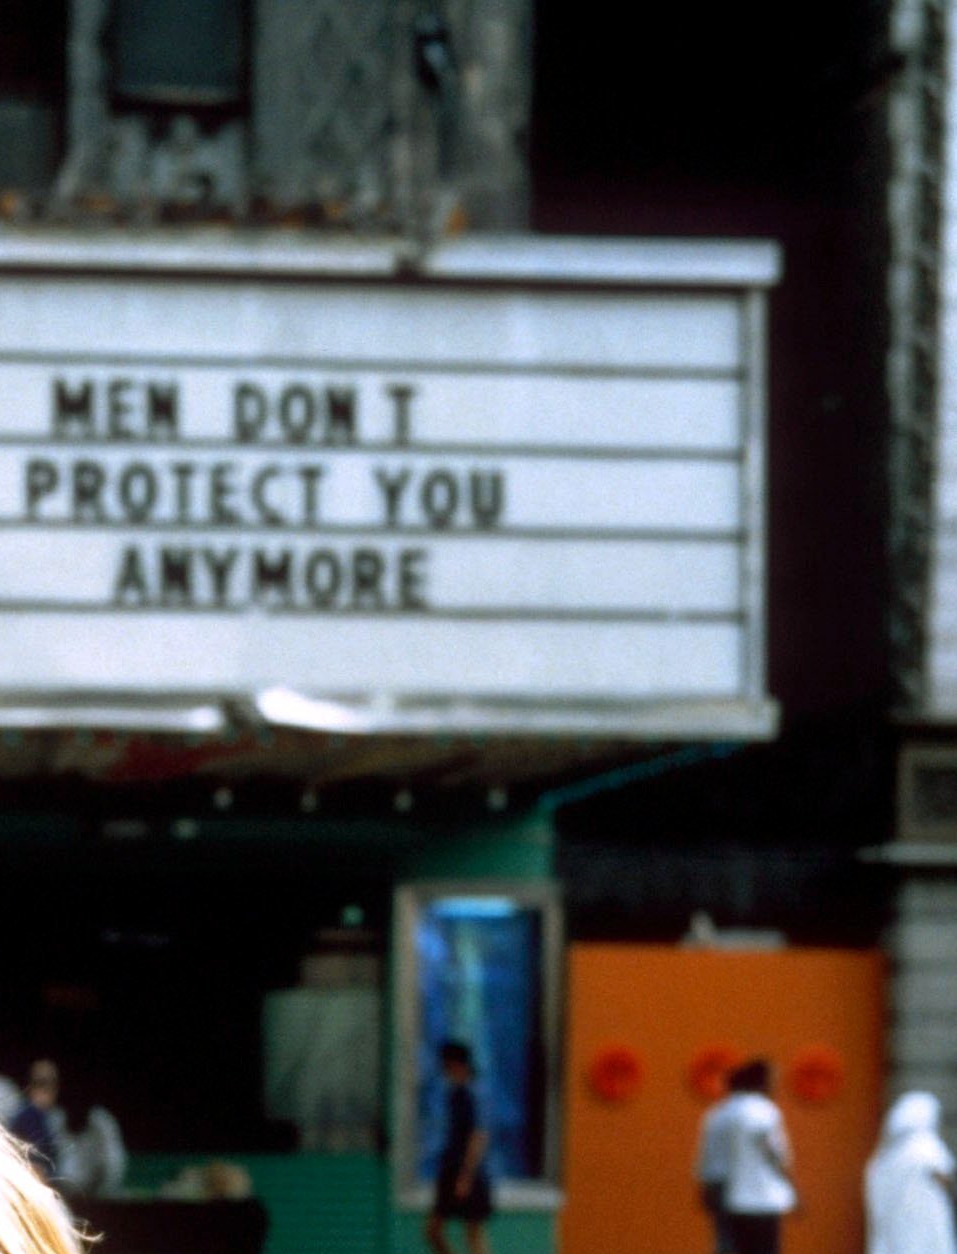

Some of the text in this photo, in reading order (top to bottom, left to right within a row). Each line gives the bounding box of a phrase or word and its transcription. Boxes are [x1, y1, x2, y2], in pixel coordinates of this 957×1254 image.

[51, 377, 180, 440] MEN
[25, 459, 507, 531] PROTECT YOU
[113, 544, 430, 608] ANYMORE
